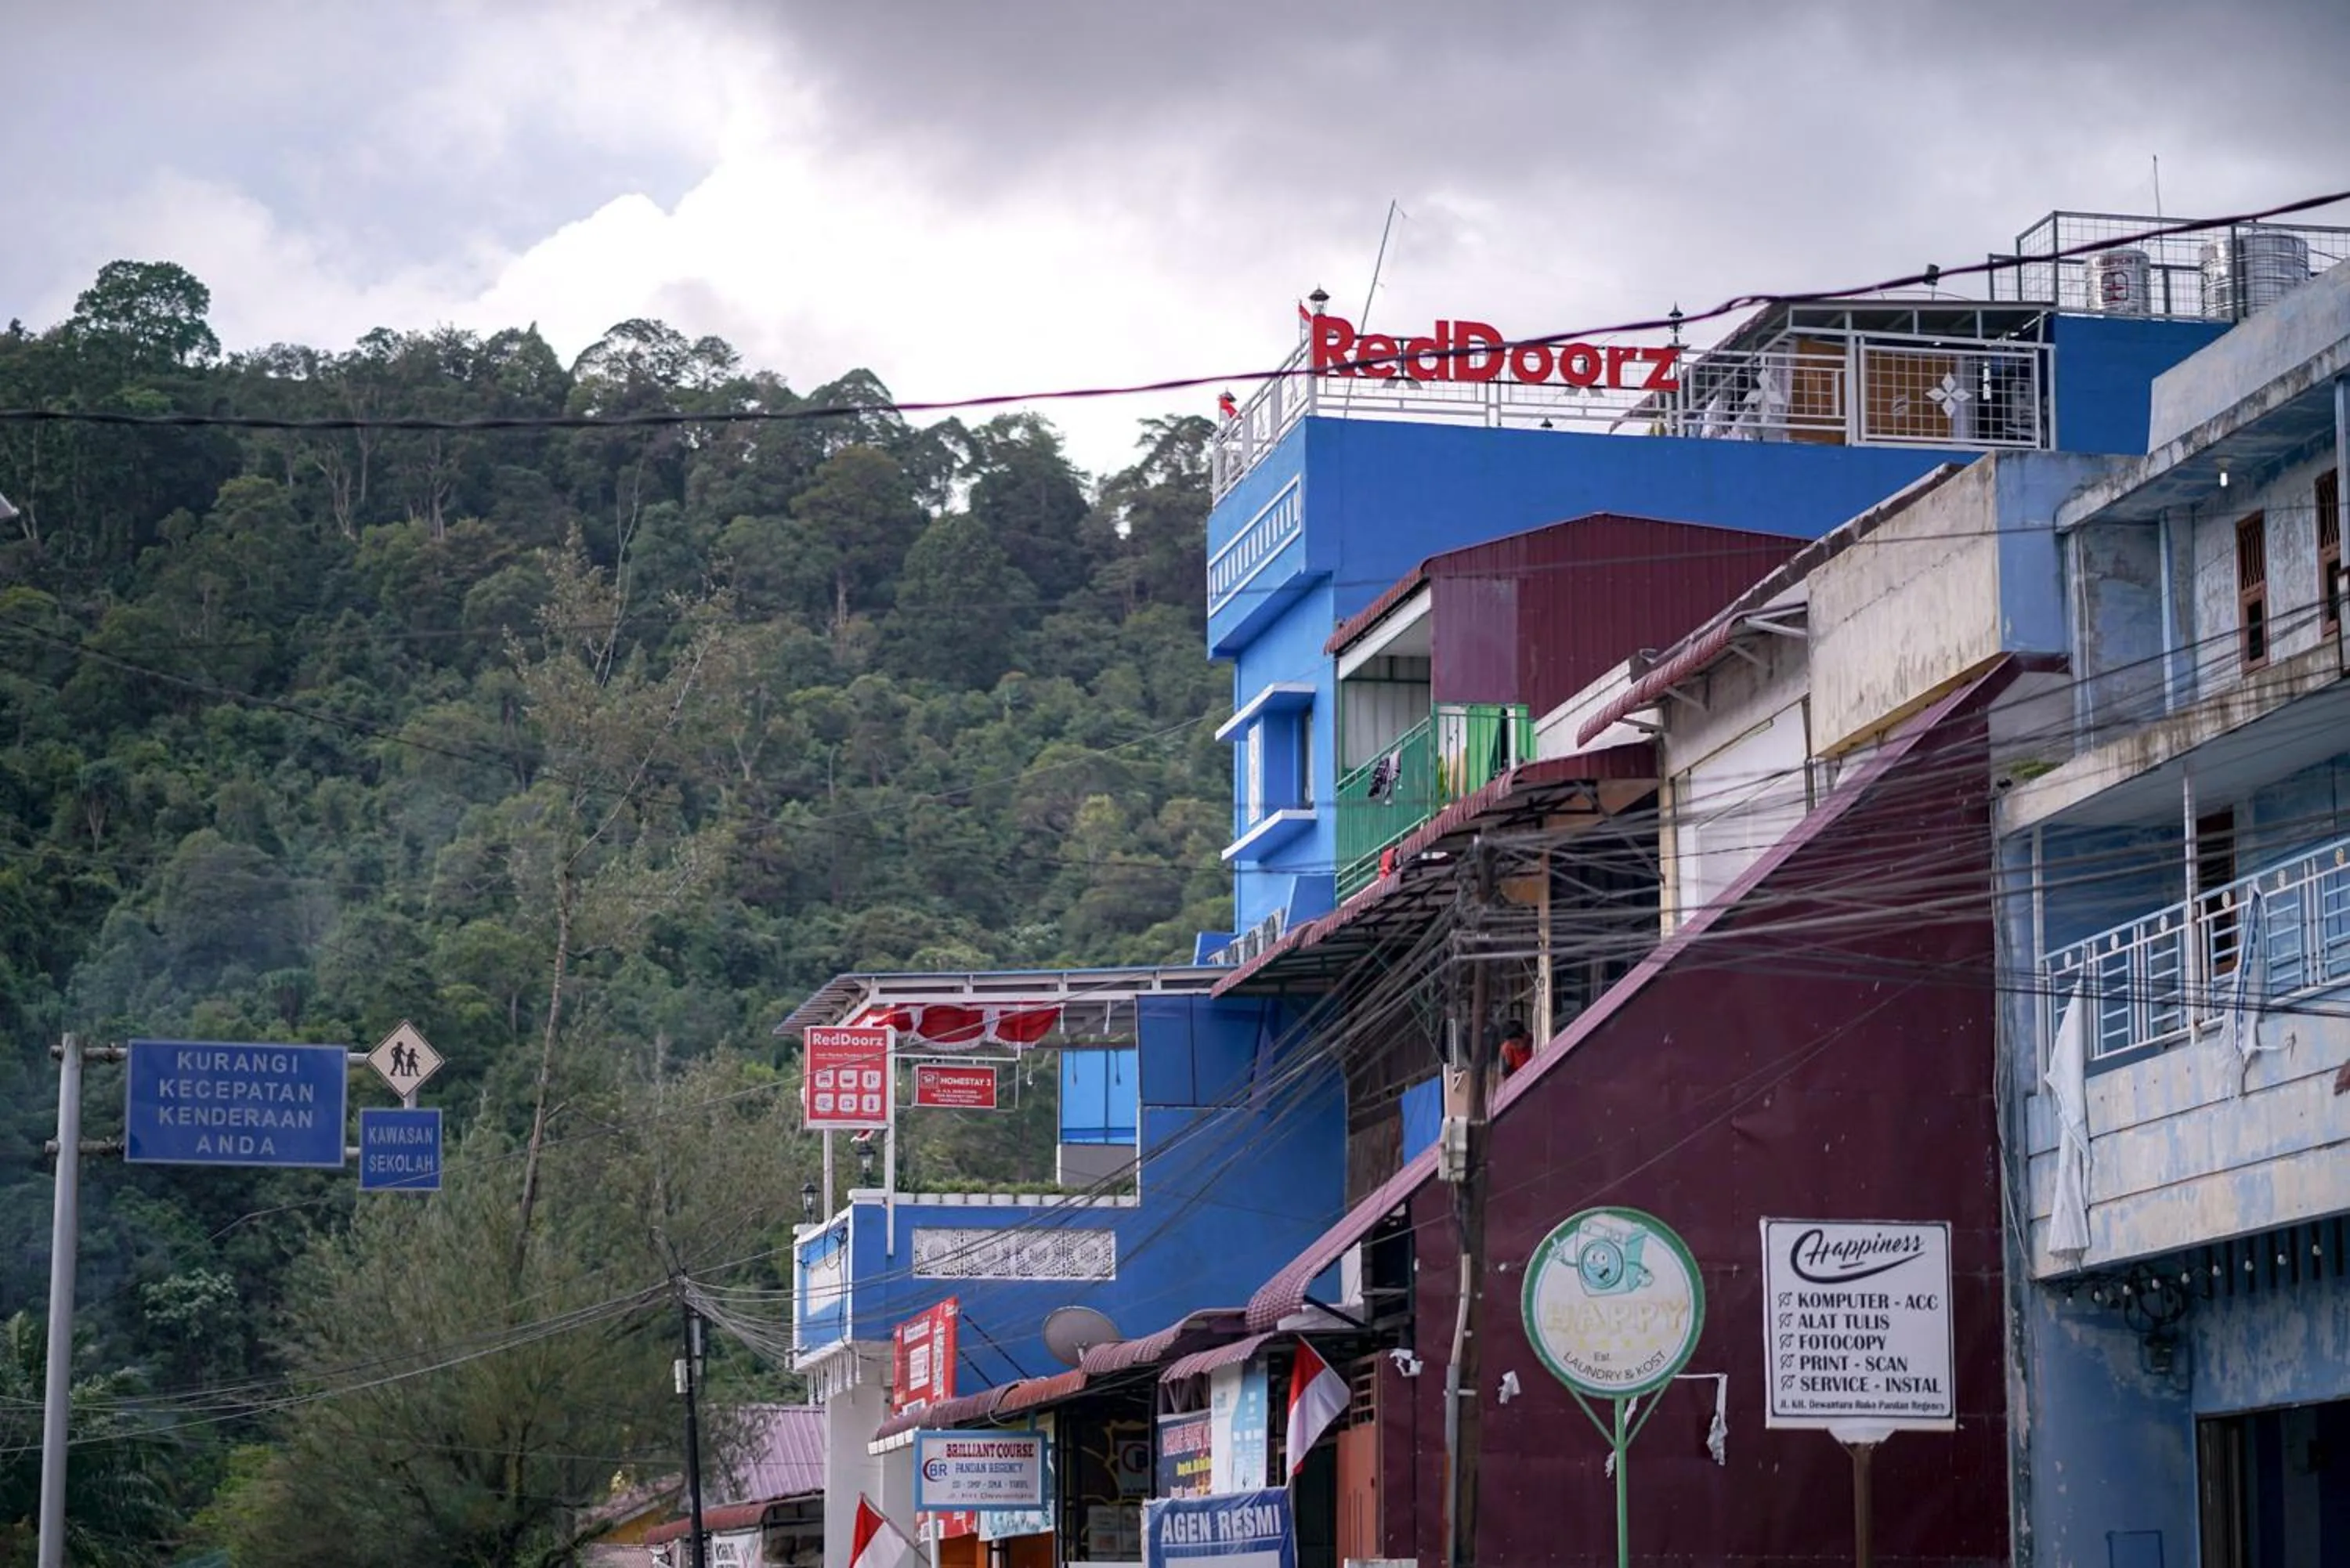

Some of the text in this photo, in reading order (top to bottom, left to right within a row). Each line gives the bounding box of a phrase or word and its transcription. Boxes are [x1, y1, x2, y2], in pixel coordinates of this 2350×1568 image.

[1312, 313, 1679, 392] RedDoorz
[813, 1033, 884, 1046] RedDoorz
[178, 1052, 297, 1074] KURANGI
[159, 1078, 313, 1103] KECEPATAN
[940, 1077, 985, 1086] HOMESTAY
[159, 1106, 313, 1128] KENDERAAN
[196, 1135, 276, 1154] ANDA
[368, 1127, 433, 1145] KAWASAN
[368, 1154, 433, 1172] SEKOLAH
[1791, 1229, 1925, 1270] Happiness
[1798, 1292, 1889, 1310] KOMPUTER
[1905, 1294, 1939, 1310] ACC
[1546, 1299, 1688, 1333] HAPPY
[1798, 1313, 1890, 1330] ALAT TULIS
[1799, 1334, 1887, 1350] FOTOCOPY
[1564, 1351, 1621, 1381] LAUNDRY
[1636, 1350, 1666, 1377] KOST
[1799, 1355, 1849, 1371] PRINT
[1865, 1356, 1908, 1372] SCAN
[1799, 1376, 1870, 1393] SERVICE
[1885, 1377, 1942, 1393] INSTAL
[1878, 1400, 1909, 1410] Pandan
[1911, 1400, 1945, 1412] Regency
[946, 1443, 1035, 1458] BRILLIANT COURSE
[930, 1464, 947, 1477] BR
[1162, 1504, 1282, 1543] AGEN RESMI
